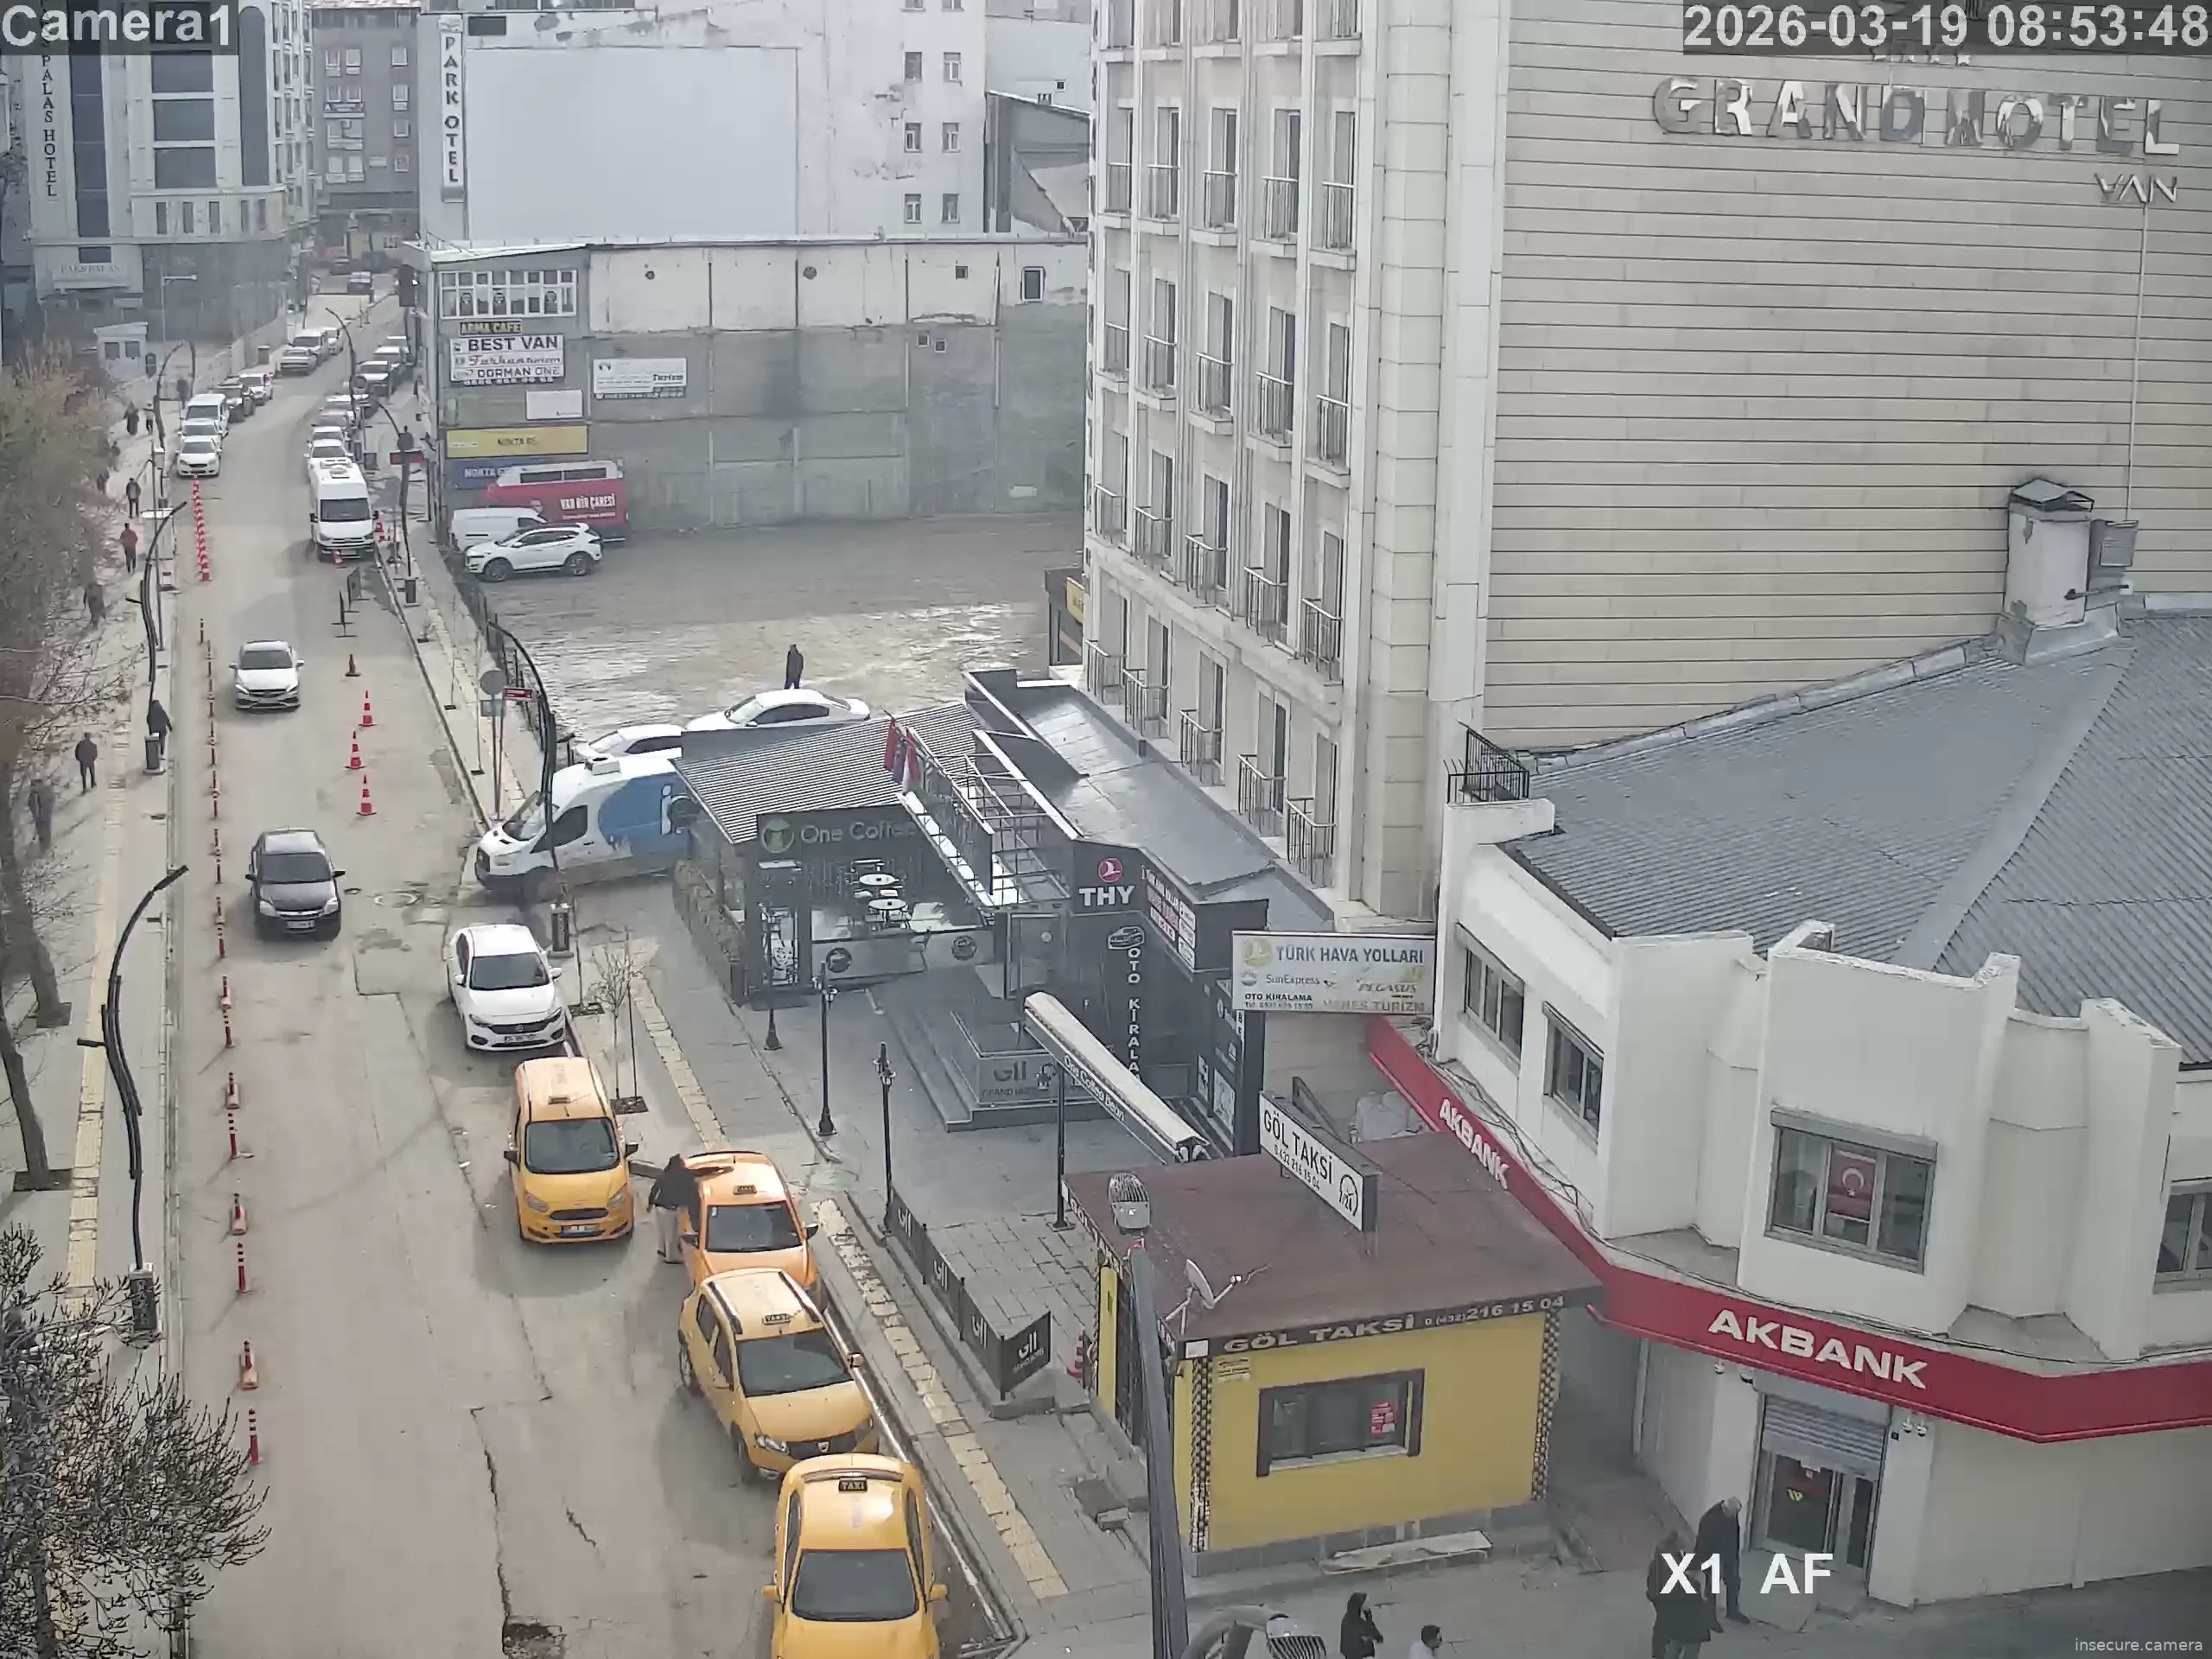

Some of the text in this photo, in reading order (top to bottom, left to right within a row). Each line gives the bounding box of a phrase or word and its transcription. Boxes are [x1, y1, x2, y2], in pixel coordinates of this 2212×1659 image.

[444, 36, 460, 182] PARK OTEL
[1653, 77, 1925, 142] GRAND
[43, 129, 58, 197] HOTEL
[2094, 173, 2177, 204] VAN
[468, 336, 558, 351] BEST VAN
[800, 825, 844, 844] One
[1078, 886, 1135, 906] THY
[1128, 948, 1141, 983] OTO
[1276, 944, 1424, 963] TÜRK HAVA YOLLARI
[1266, 974, 1320, 986] SunExpress
[1263, 1109, 1332, 1185] GÖL TAKSİ
[1439, 1098, 1510, 1191] AKBANK
[1224, 1332, 1297, 1352] GÖL
[1309, 1314, 1414, 1342] TAKSİ
[1512, 1300, 1535, 1314] 15
[1540, 1296, 1564, 1309] 04
[1707, 1309, 1929, 1389] AKBANK
[842, 1481, 865, 1491] TAXI
